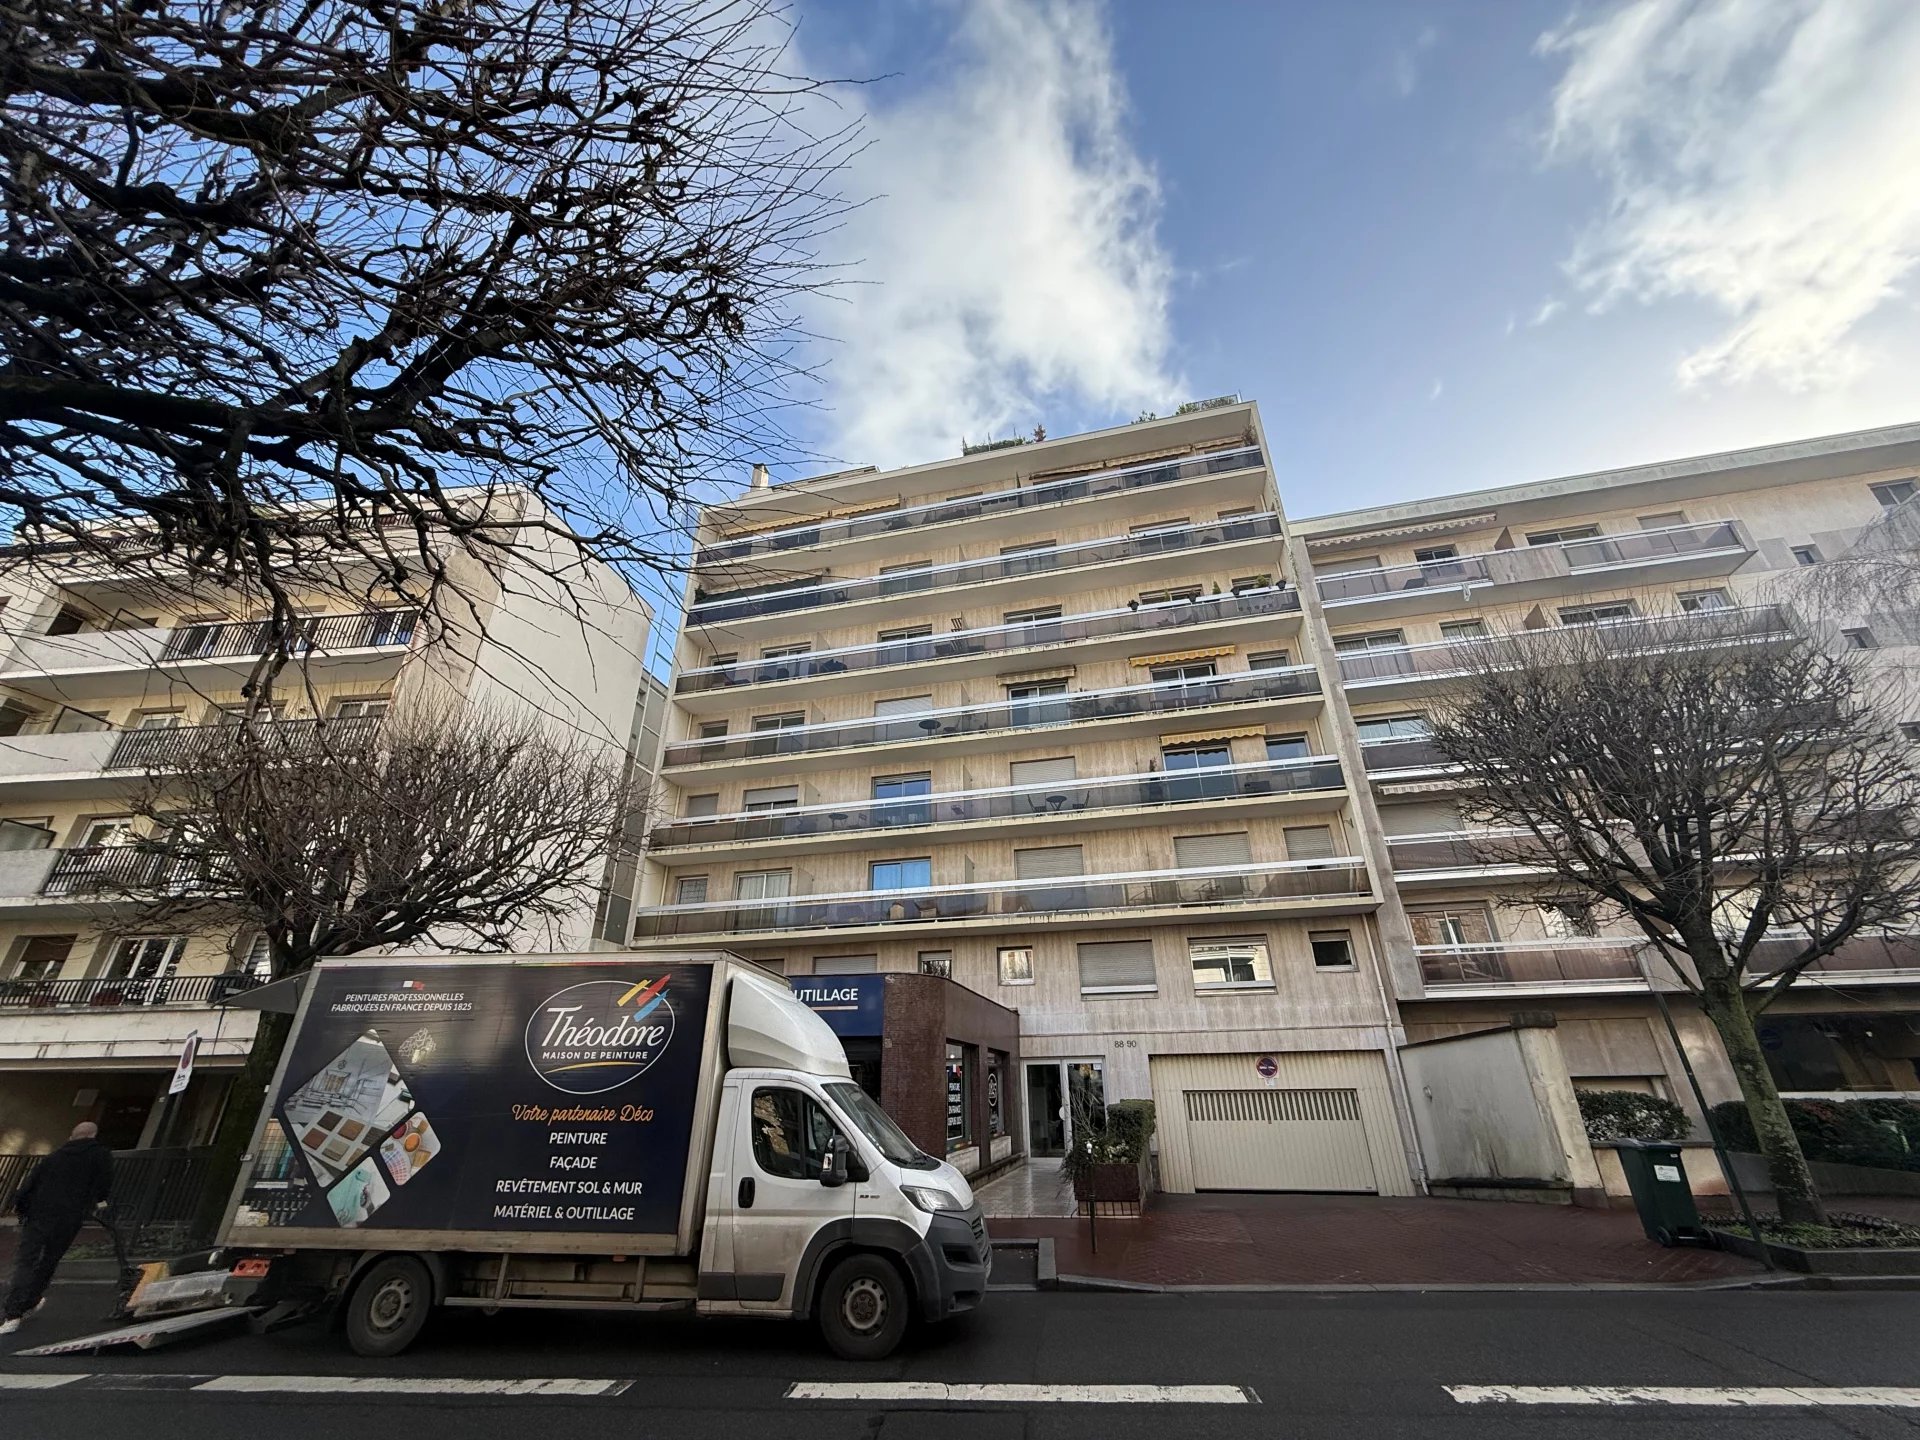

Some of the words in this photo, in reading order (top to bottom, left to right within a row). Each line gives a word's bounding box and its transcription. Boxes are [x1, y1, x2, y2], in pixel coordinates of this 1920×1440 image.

[345, 993, 388, 1002] PEINTURES
[387, 992, 465, 1002] PROFESSIONNELLES
[331, 1002, 380, 1013] FABRIQUÉES
[379, 1003, 392, 1012] EN
[391, 1003, 424, 1012] FRANCE
[423, 1002, 453, 1012] DEPUIS
[453, 1002, 473, 1011] 1825
[541, 1004, 665, 1047] Théodore
[1114, 1040, 1124, 1048] 88
[542, 1051, 581, 1060] MAISON
[584, 1051, 597, 1060] DE
[600, 1051, 649, 1060] PEINTURE
[511, 1104, 549, 1122] Votre
[547, 1104, 617, 1126] partenaire
[619, 1104, 654, 1122] Déco
[549, 1132, 608, 1145] PEINTURE
[549, 1156, 598, 1171] FAÇADE
[495, 1178, 576, 1194] REVÊTEMENT
[576, 1181, 600, 1194] SOL
[602, 1181, 611, 1194] &
[613, 1182, 643, 1195] MUR
[493, 1202, 552, 1219] MATÉRIEL
[554, 1206, 564, 1219] &
[566, 1206, 635, 1220] OUTILLAGE
